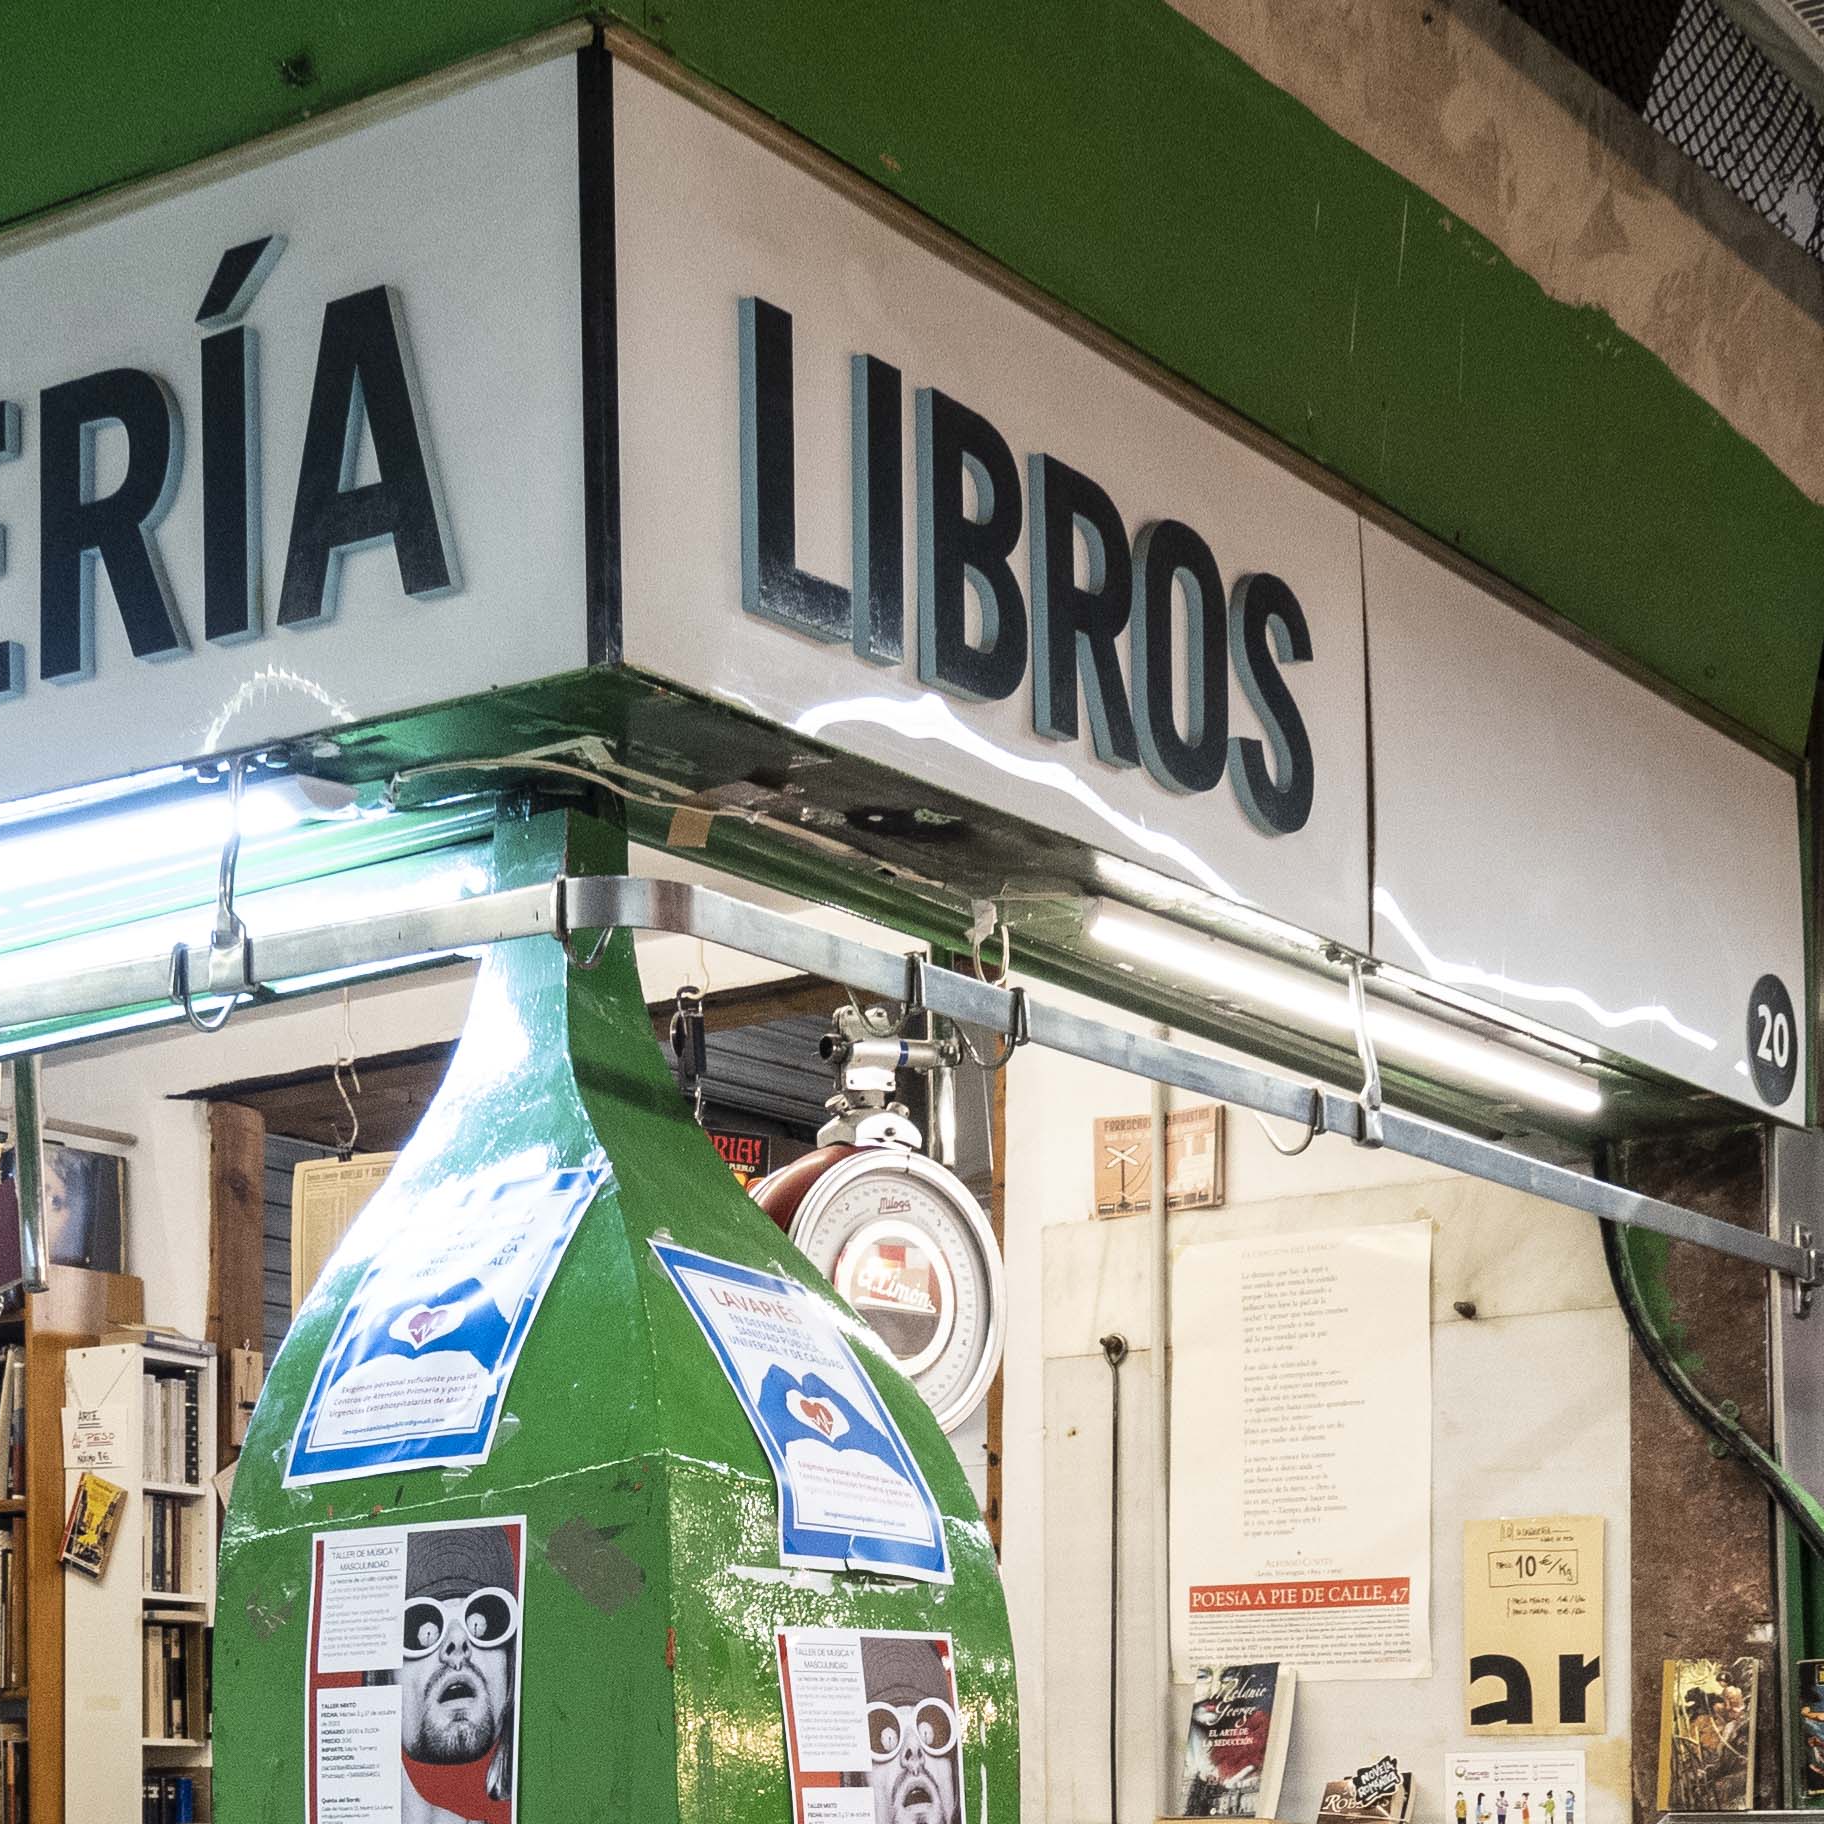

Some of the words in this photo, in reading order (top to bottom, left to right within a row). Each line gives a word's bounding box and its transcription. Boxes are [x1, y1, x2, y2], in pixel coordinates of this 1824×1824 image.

[738, 294, 1313, 837] LIBROS
[1757, 1004, 1789, 1068] 20
[710, 1287, 802, 1324] LAVAPIÉS
[333, 1550, 355, 1560] TALLER
[1254, 1592, 1268, 1605] A
[1270, 1588, 1297, 1605] PIE
[1302, 1587, 1325, 1604] DE
[1328, 1585, 1387, 1603] CALLE,
[1390, 1586, 1408, 1602] 47
[1209, 1675, 1267, 1702] Melanie
[1220, 1728, 1237, 1737] ARTE
[1361, 1759, 1393, 1784] NOVELA
